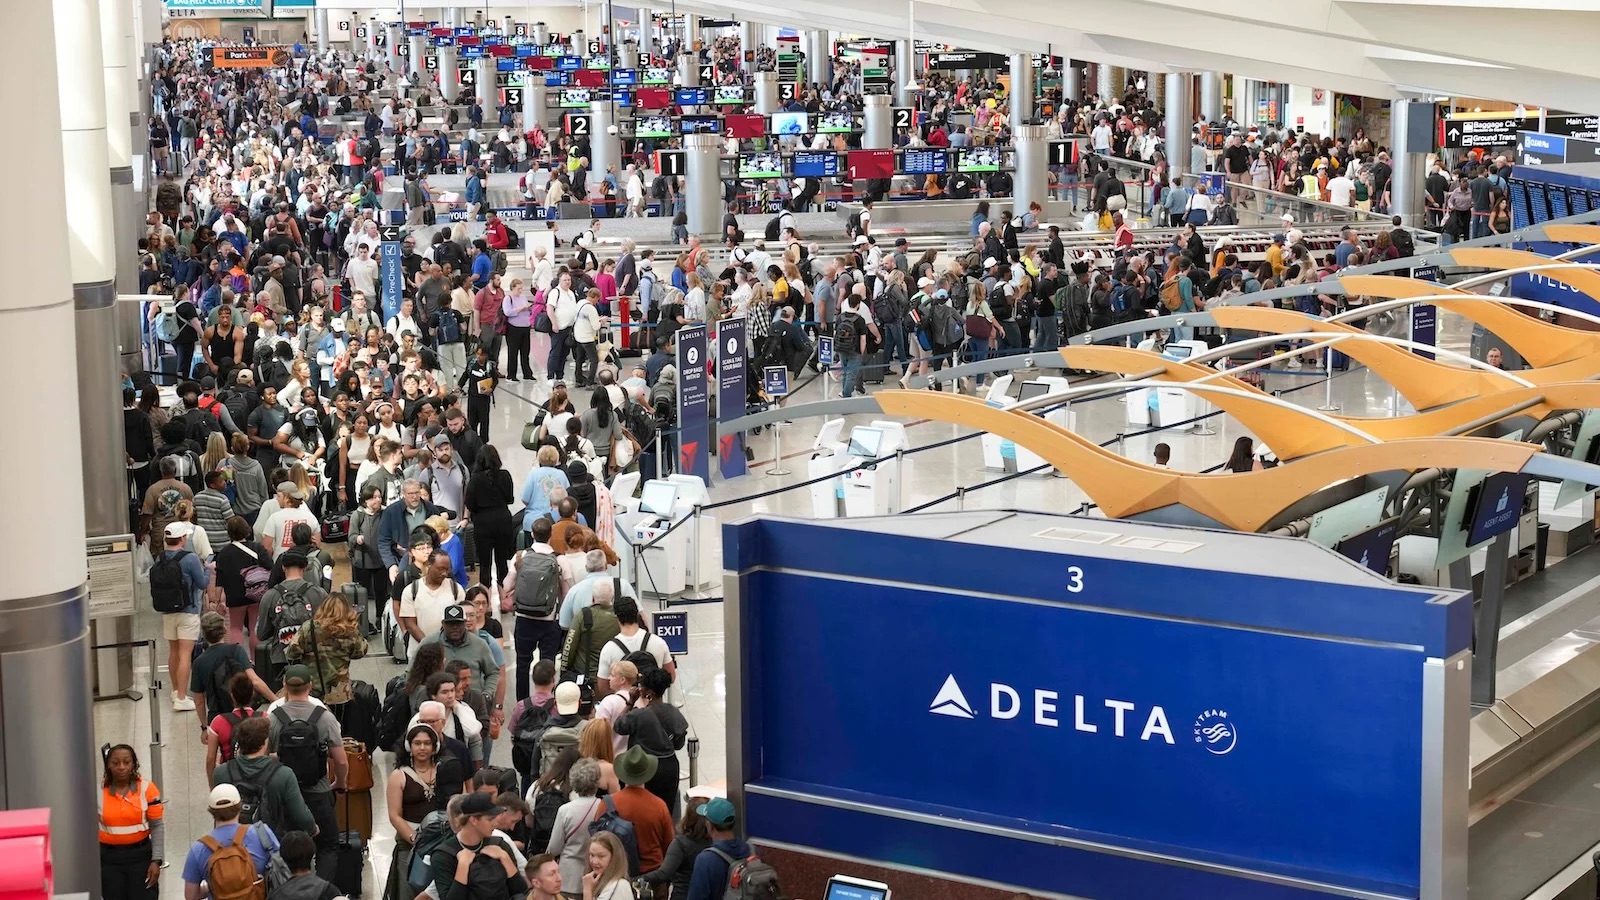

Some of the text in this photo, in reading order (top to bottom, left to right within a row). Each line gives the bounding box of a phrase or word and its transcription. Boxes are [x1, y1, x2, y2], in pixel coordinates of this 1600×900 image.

[517, 27, 524, 35] 8
[377, 36, 384, 44] 7
[551, 34, 558, 43] 7
[590, 42, 598, 52] 6
[427, 57, 436, 68] 5
[640, 54, 649, 64] 5
[462, 71, 473, 83] 4
[701, 68, 712, 79] 4
[508, 90, 519, 104] 3
[782, 85, 792, 98] 3
[638, 99, 644, 108] 3
[897, 110, 908, 126] 2
[574, 118, 587, 134] 2
[1474, 121, 1504, 129] Baggage
[727, 128, 734, 137] 2
[1058, 144, 1064, 163] 1
[669, 154, 677, 174] 1
[850, 166, 856, 177] 1
[768, 203, 780, 211] YOU
[388, 259, 396, 294] PreCheck
[686, 332, 700, 340] DELTA
[731, 342, 734, 351] 1
[690, 350, 695, 360] 2
[1314, 516, 1324, 528] 57
[1483, 510, 1512, 529] AGENT ASSIST
[1067, 566, 1084, 593] 3
[658, 626, 683, 636] EXIT
[561, 628, 576, 671] FREEDOM
[990, 682, 1176, 745] DELTA
[1194, 709, 1228, 742] SKYTEAM
